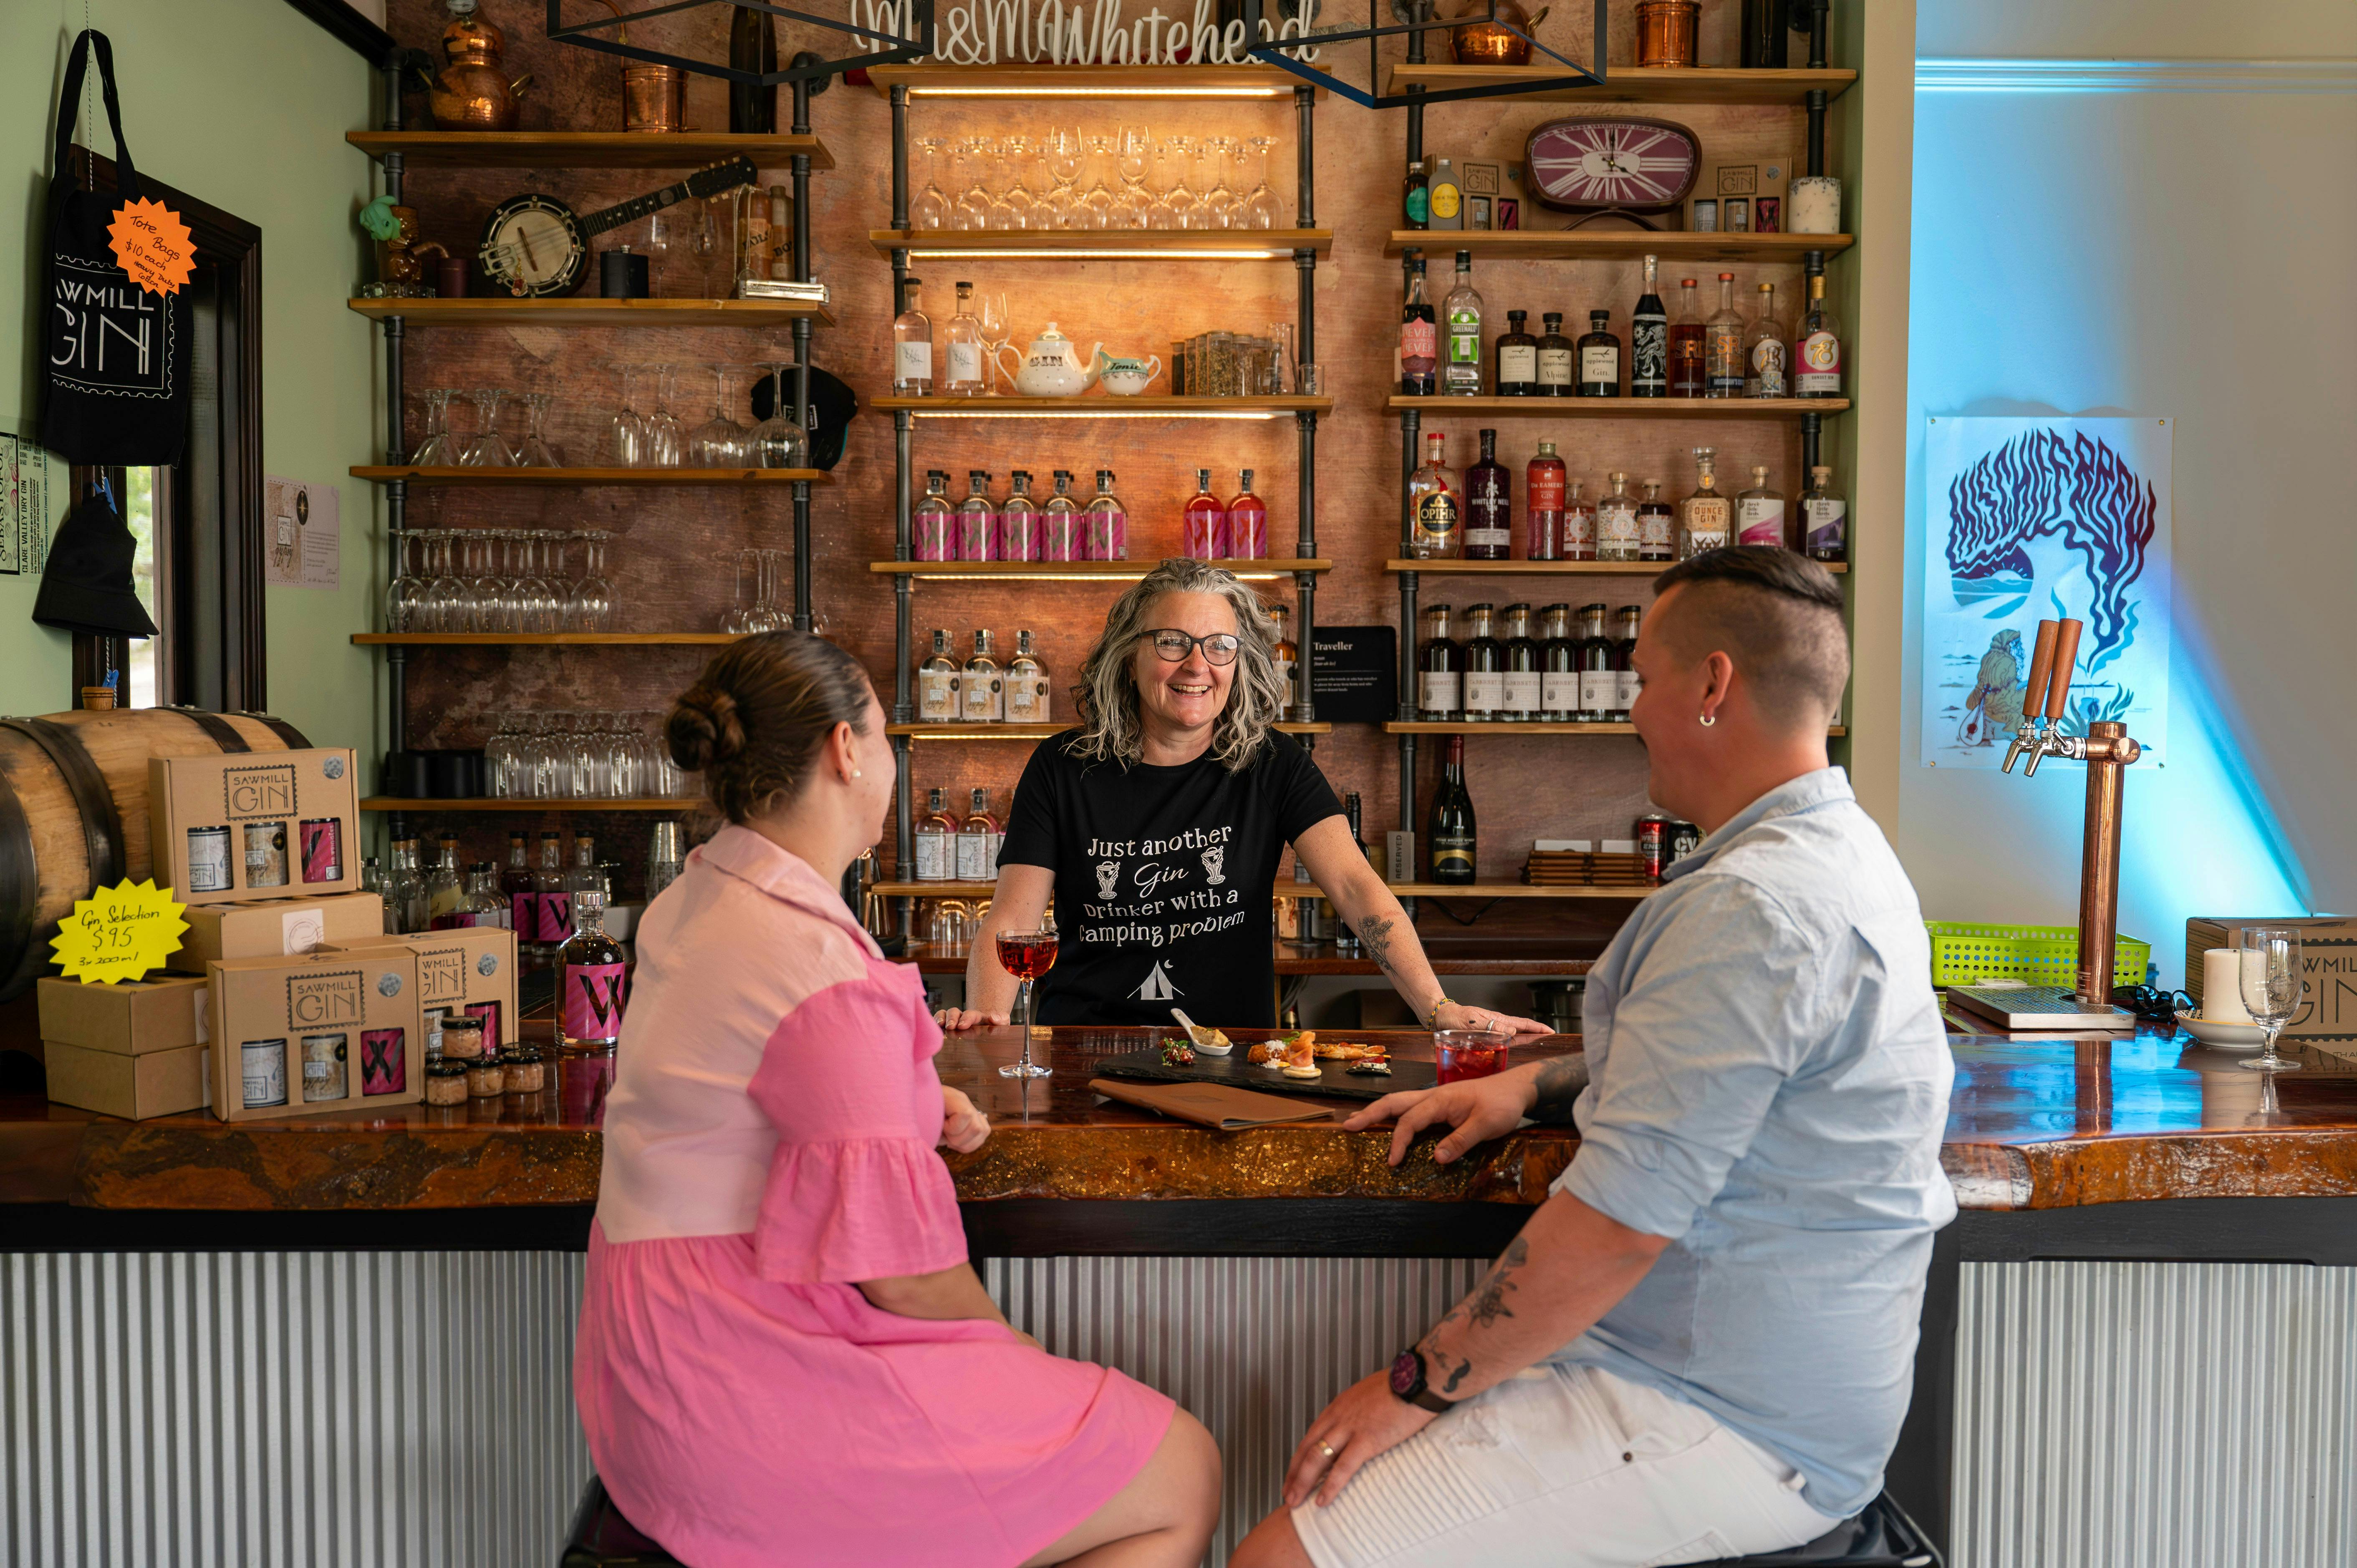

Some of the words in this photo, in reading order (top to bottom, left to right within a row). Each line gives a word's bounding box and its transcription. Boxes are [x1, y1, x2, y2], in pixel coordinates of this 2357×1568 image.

[1721, 176, 1753, 192] GIN
[130, 215, 157, 234] Tote
[125, 238, 143, 257] $10
[144, 255, 167, 271] each
[152, 237, 180, 262] Bags
[773, 240, 792, 257] BO
[133, 260, 155, 277] Heavy
[158, 273, 175, 289] Duty
[56, 278, 154, 311] WMILL
[1029, 356, 1063, 367] GIN
[1110, 362, 1141, 371] Tonic
[1420, 508, 1456, 520] OPIHR
[1694, 507, 1723, 515] OUNCE
[1700, 514, 1716, 523] GIN
[1313, 641, 1353, 651] Traveller
[233, 774, 289, 786] SAWMILL
[232, 784, 289, 812] GIN
[1088, 838, 1136, 857] Just
[1141, 826, 1232, 856] another
[1134, 862, 1189, 898] Gin
[1083, 900, 1164, 919] Drinker
[1171, 888, 1221, 911] with
[1226, 889, 1238, 904] a
[81, 910, 100, 930] Gin
[107, 905, 159, 924] Selection
[92, 924, 134, 952] $95
[1080, 921, 1164, 948] Camping
[1168, 911, 1245, 944] problem
[422, 958, 459, 970] WMILL
[297, 981, 356, 994] SAWMILL
[296, 993, 356, 1022] GIN
